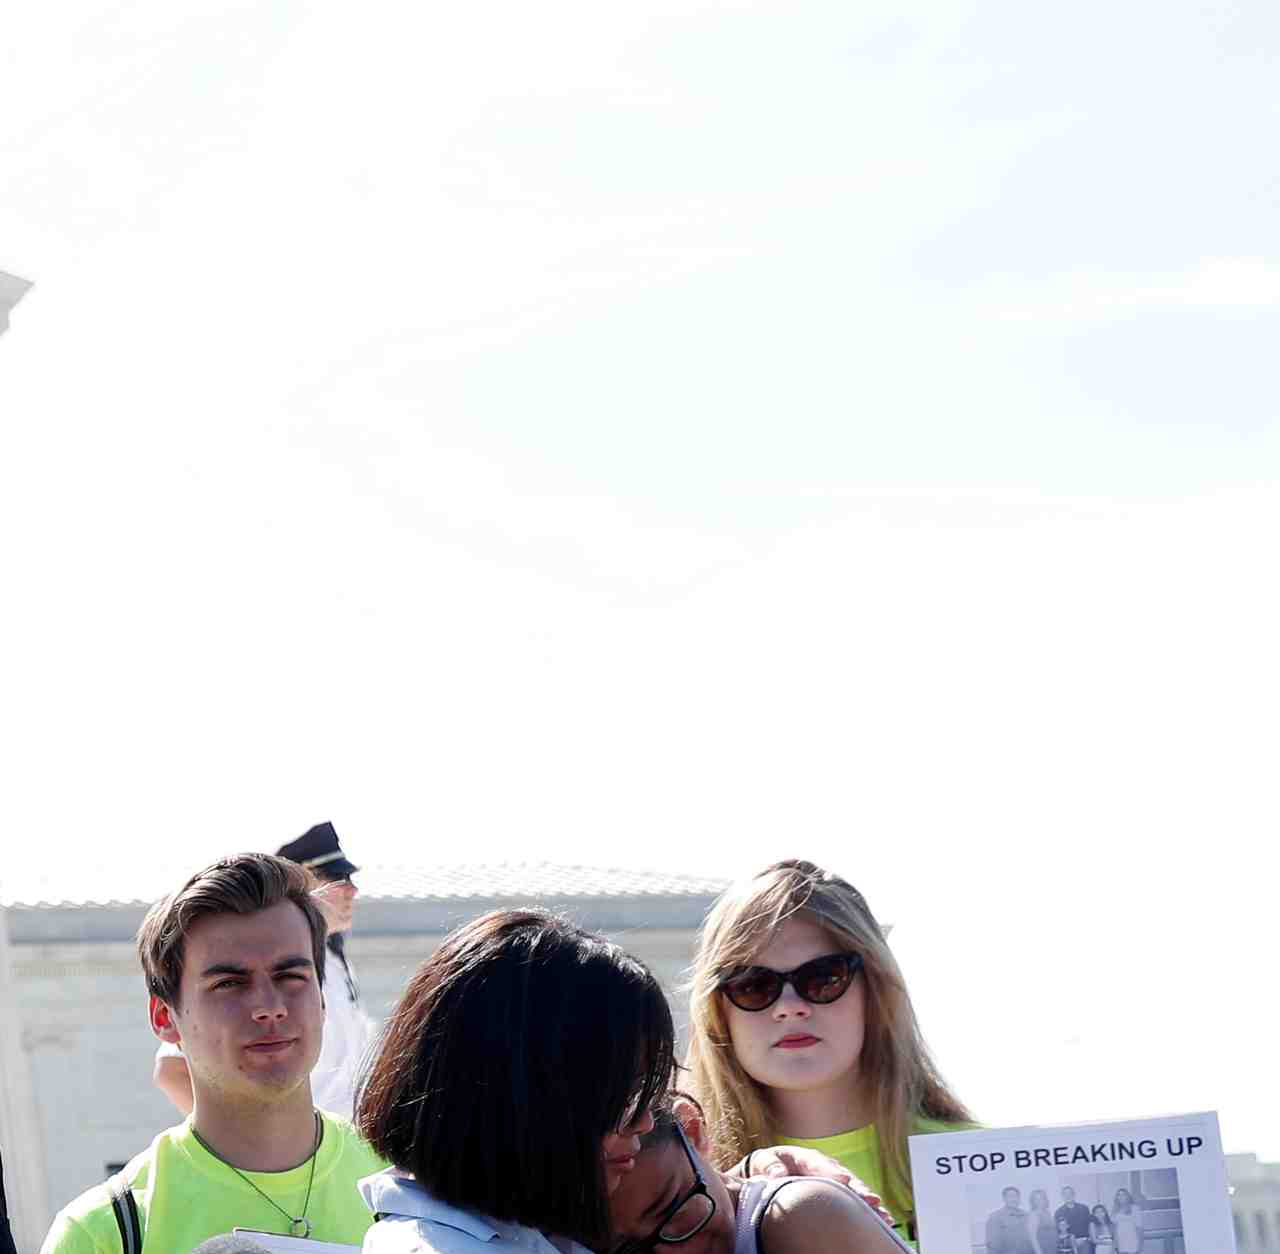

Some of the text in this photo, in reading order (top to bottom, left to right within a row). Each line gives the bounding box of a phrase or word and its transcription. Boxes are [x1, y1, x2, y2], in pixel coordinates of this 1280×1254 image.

[936, 1136, 1203, 1175] STOP BREAKING UP
